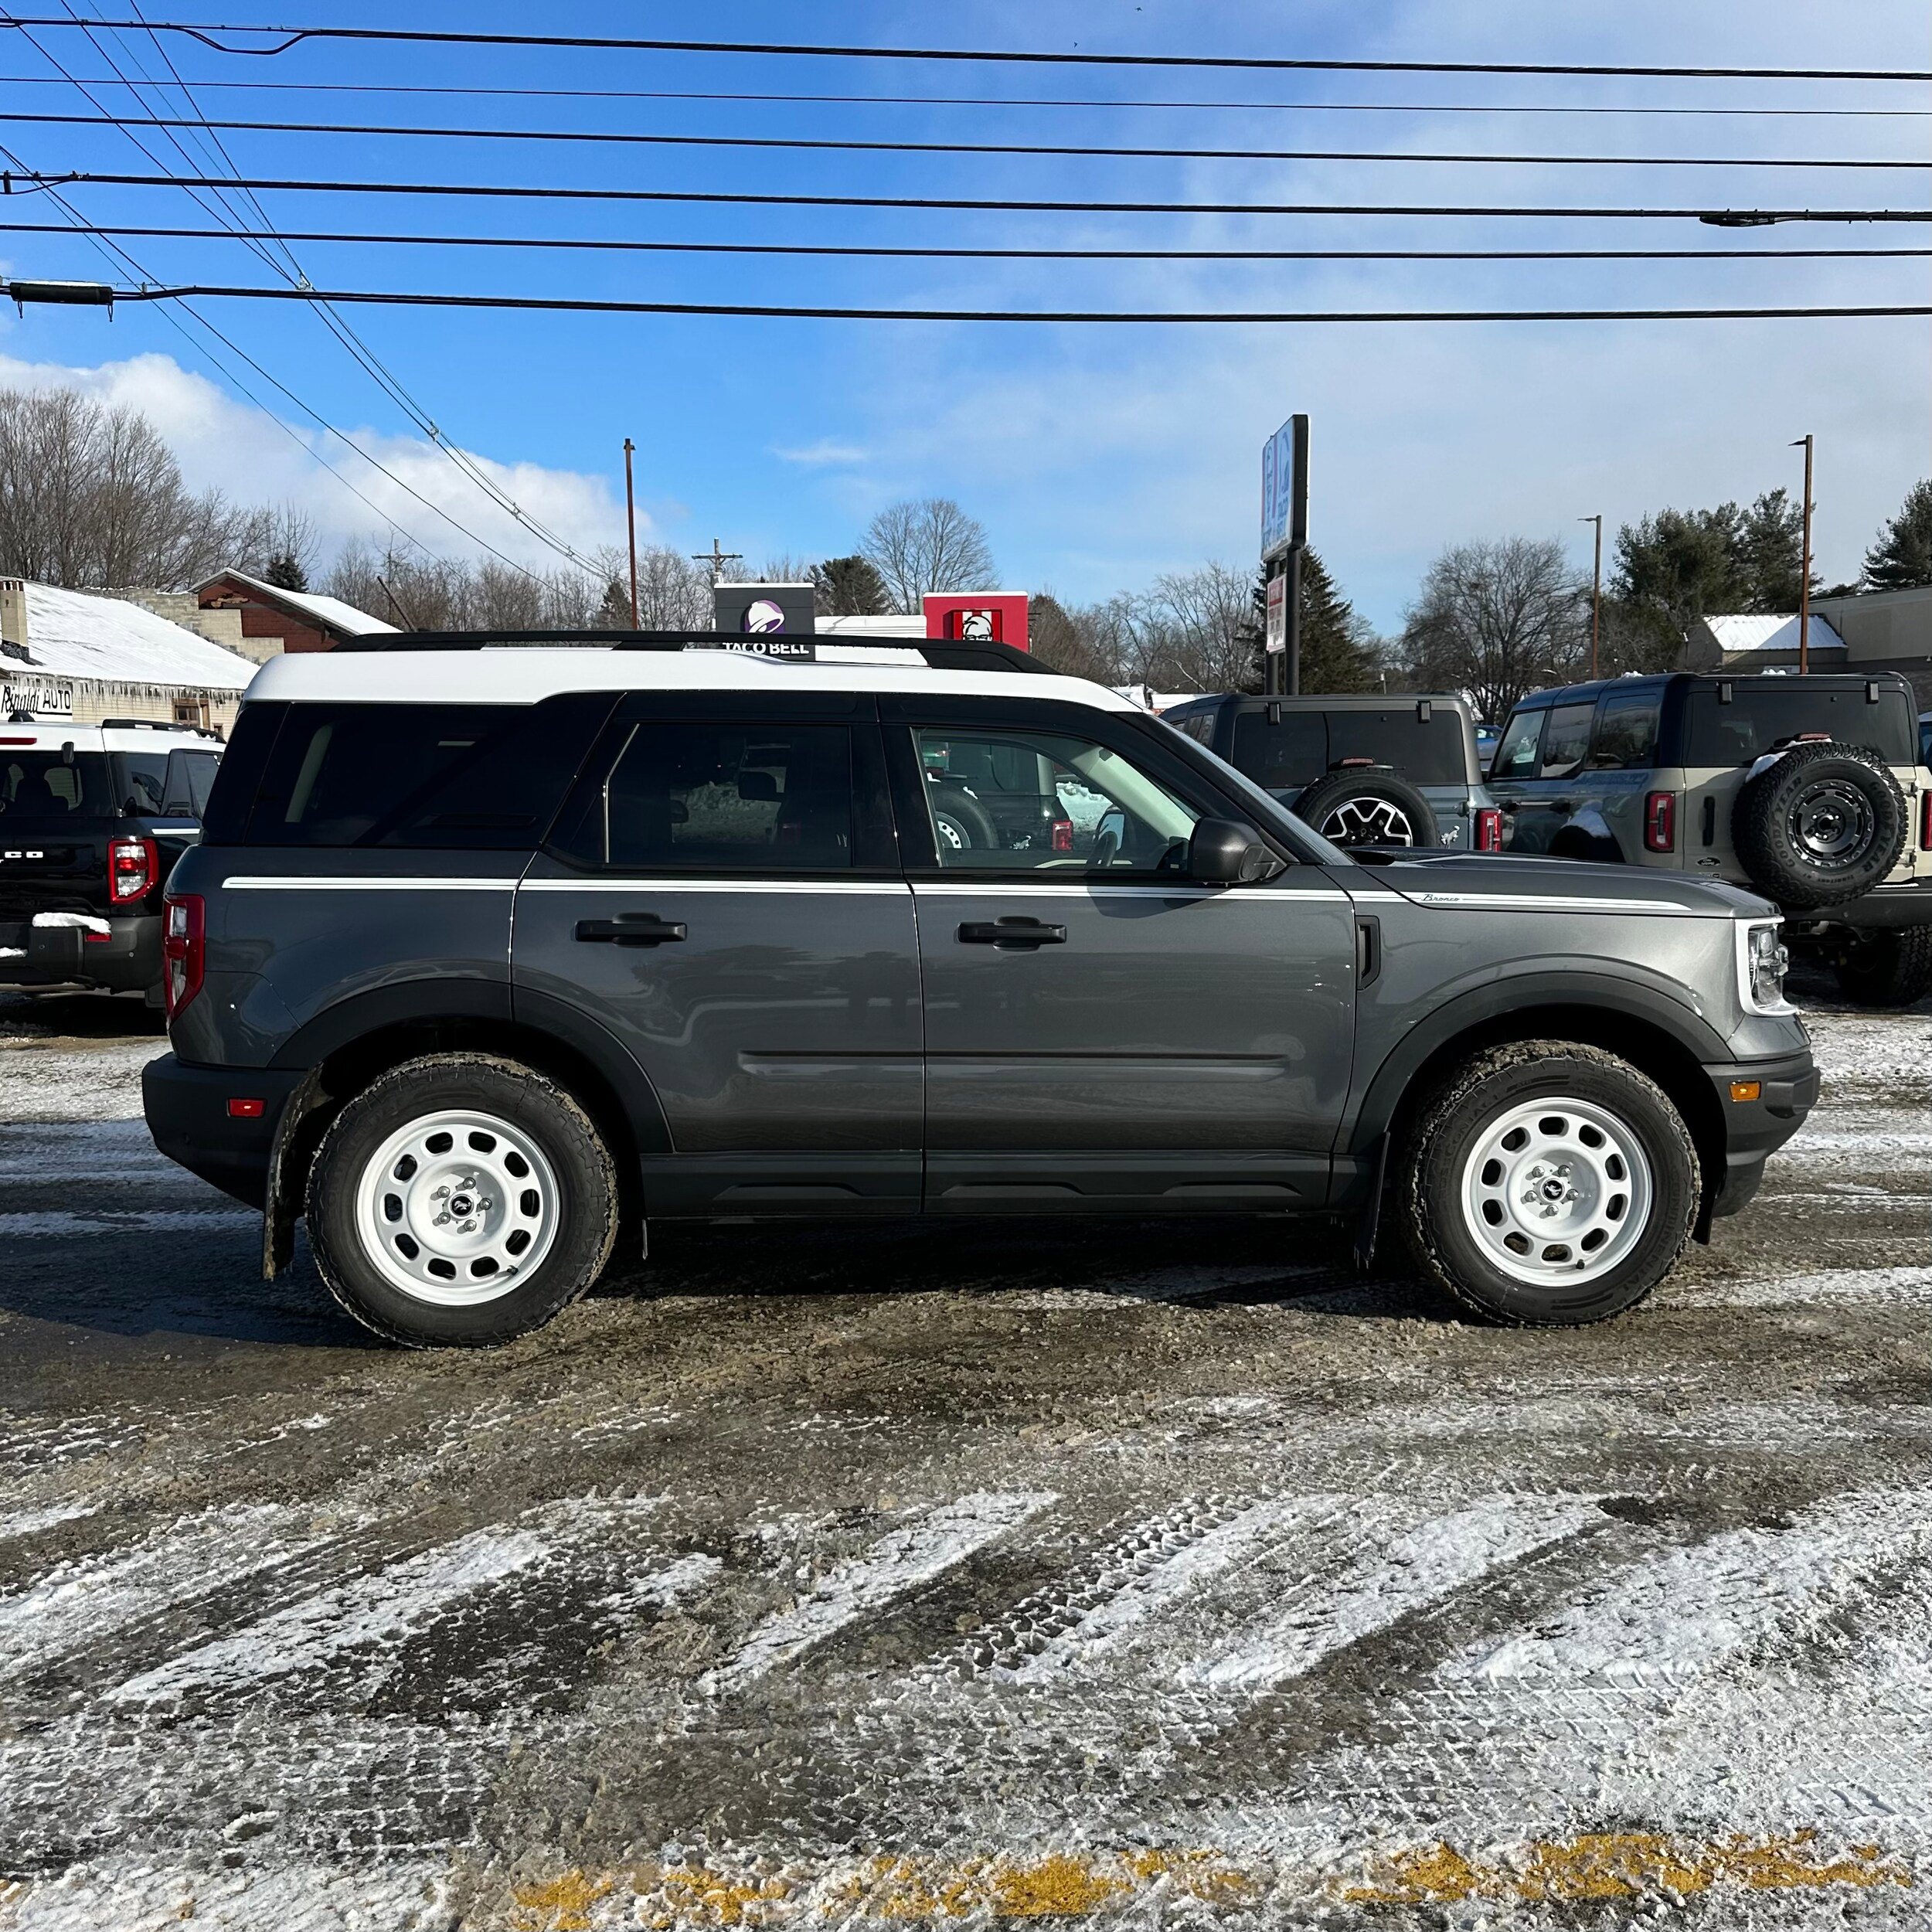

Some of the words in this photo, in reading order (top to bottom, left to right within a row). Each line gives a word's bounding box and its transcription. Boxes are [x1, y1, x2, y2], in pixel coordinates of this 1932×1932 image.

[723, 643, 766, 654] TACO
[770, 644, 809, 654] BELL
[43, 689, 70, 709] AUTO
[1421, 893, 1460, 902] Bronco
